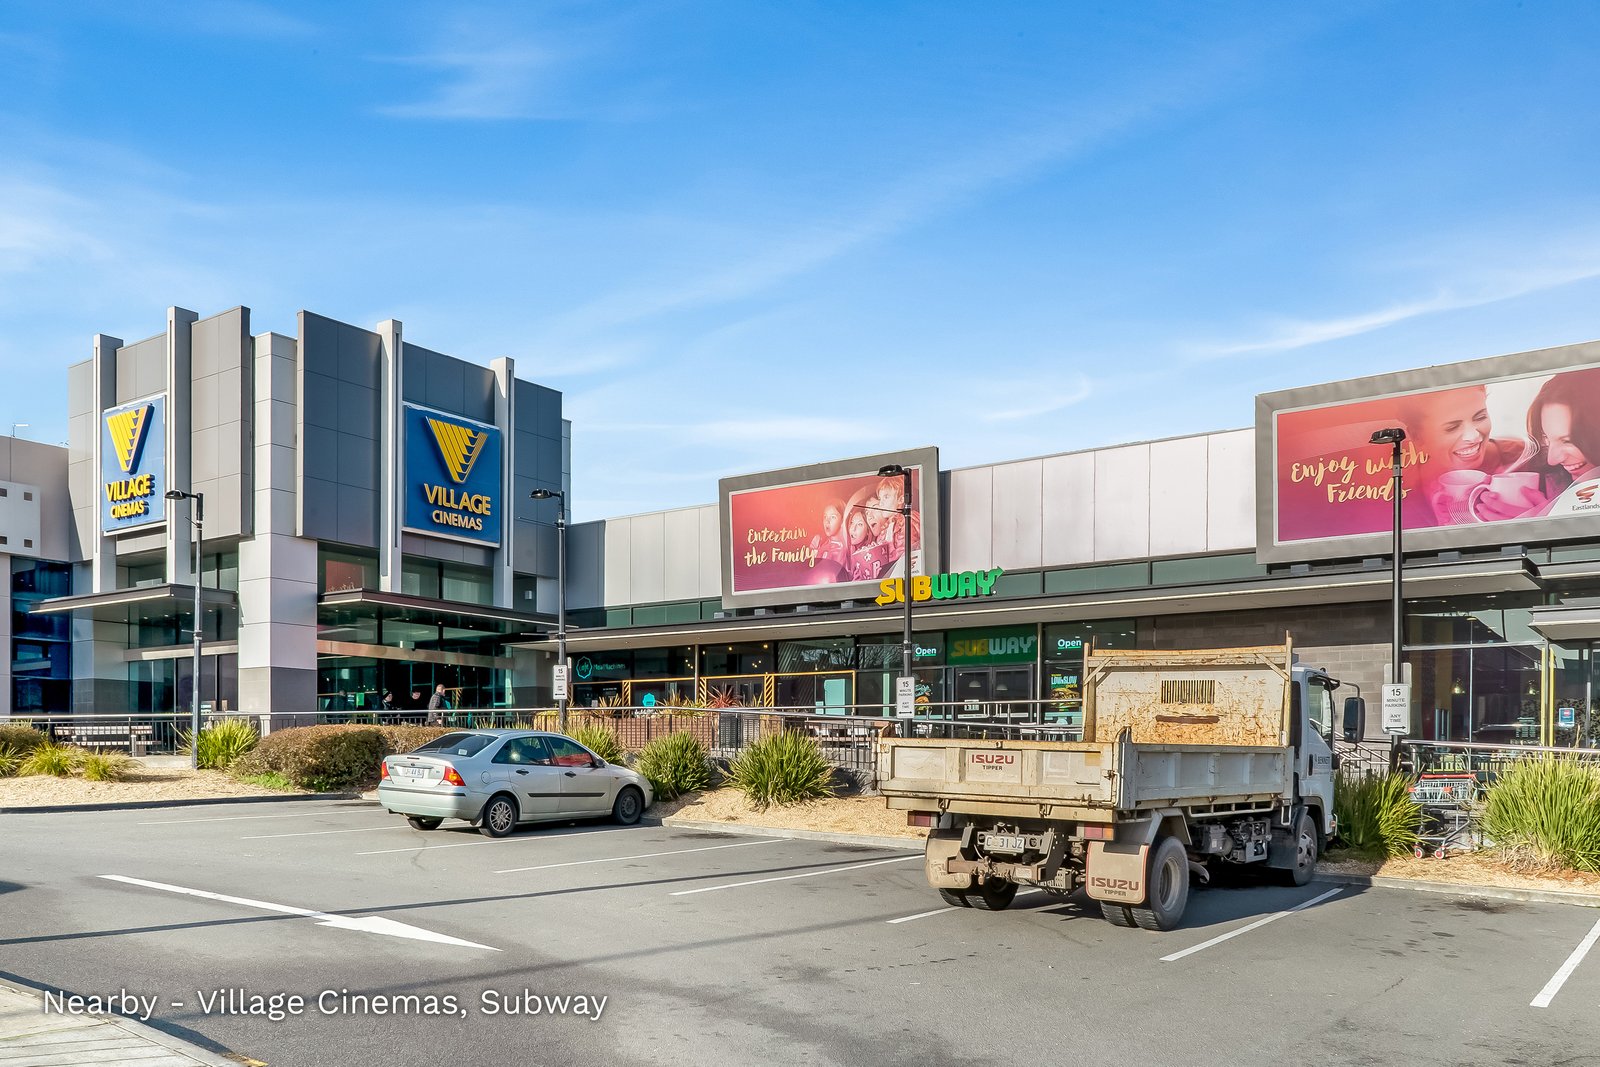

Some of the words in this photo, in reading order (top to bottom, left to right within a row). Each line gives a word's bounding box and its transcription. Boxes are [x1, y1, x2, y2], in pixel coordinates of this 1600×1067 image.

[1291, 456, 1359, 487] Enjoy
[1366, 441, 1429, 475] with
[105, 474, 153, 502] VILLAGE
[1327, 477, 1412, 502] Friends
[110, 500, 146, 519] CINEMAS
[423, 483, 491, 516] VILLAGE
[432, 509, 483, 531] CINEMAS
[747, 526, 807, 544] Entertain
[744, 546, 768, 567] the
[772, 545, 816, 568] Family
[875, 566, 1003, 606] SUBWAY
[915, 647, 937, 656] Open
[951, 635, 1037, 657] SUBWAY
[1058, 639, 1082, 649] Open
[1391, 688, 1401, 696] 15
[971, 754, 1015, 765] ISUZU
[1091, 877, 1140, 891] ISUZU
